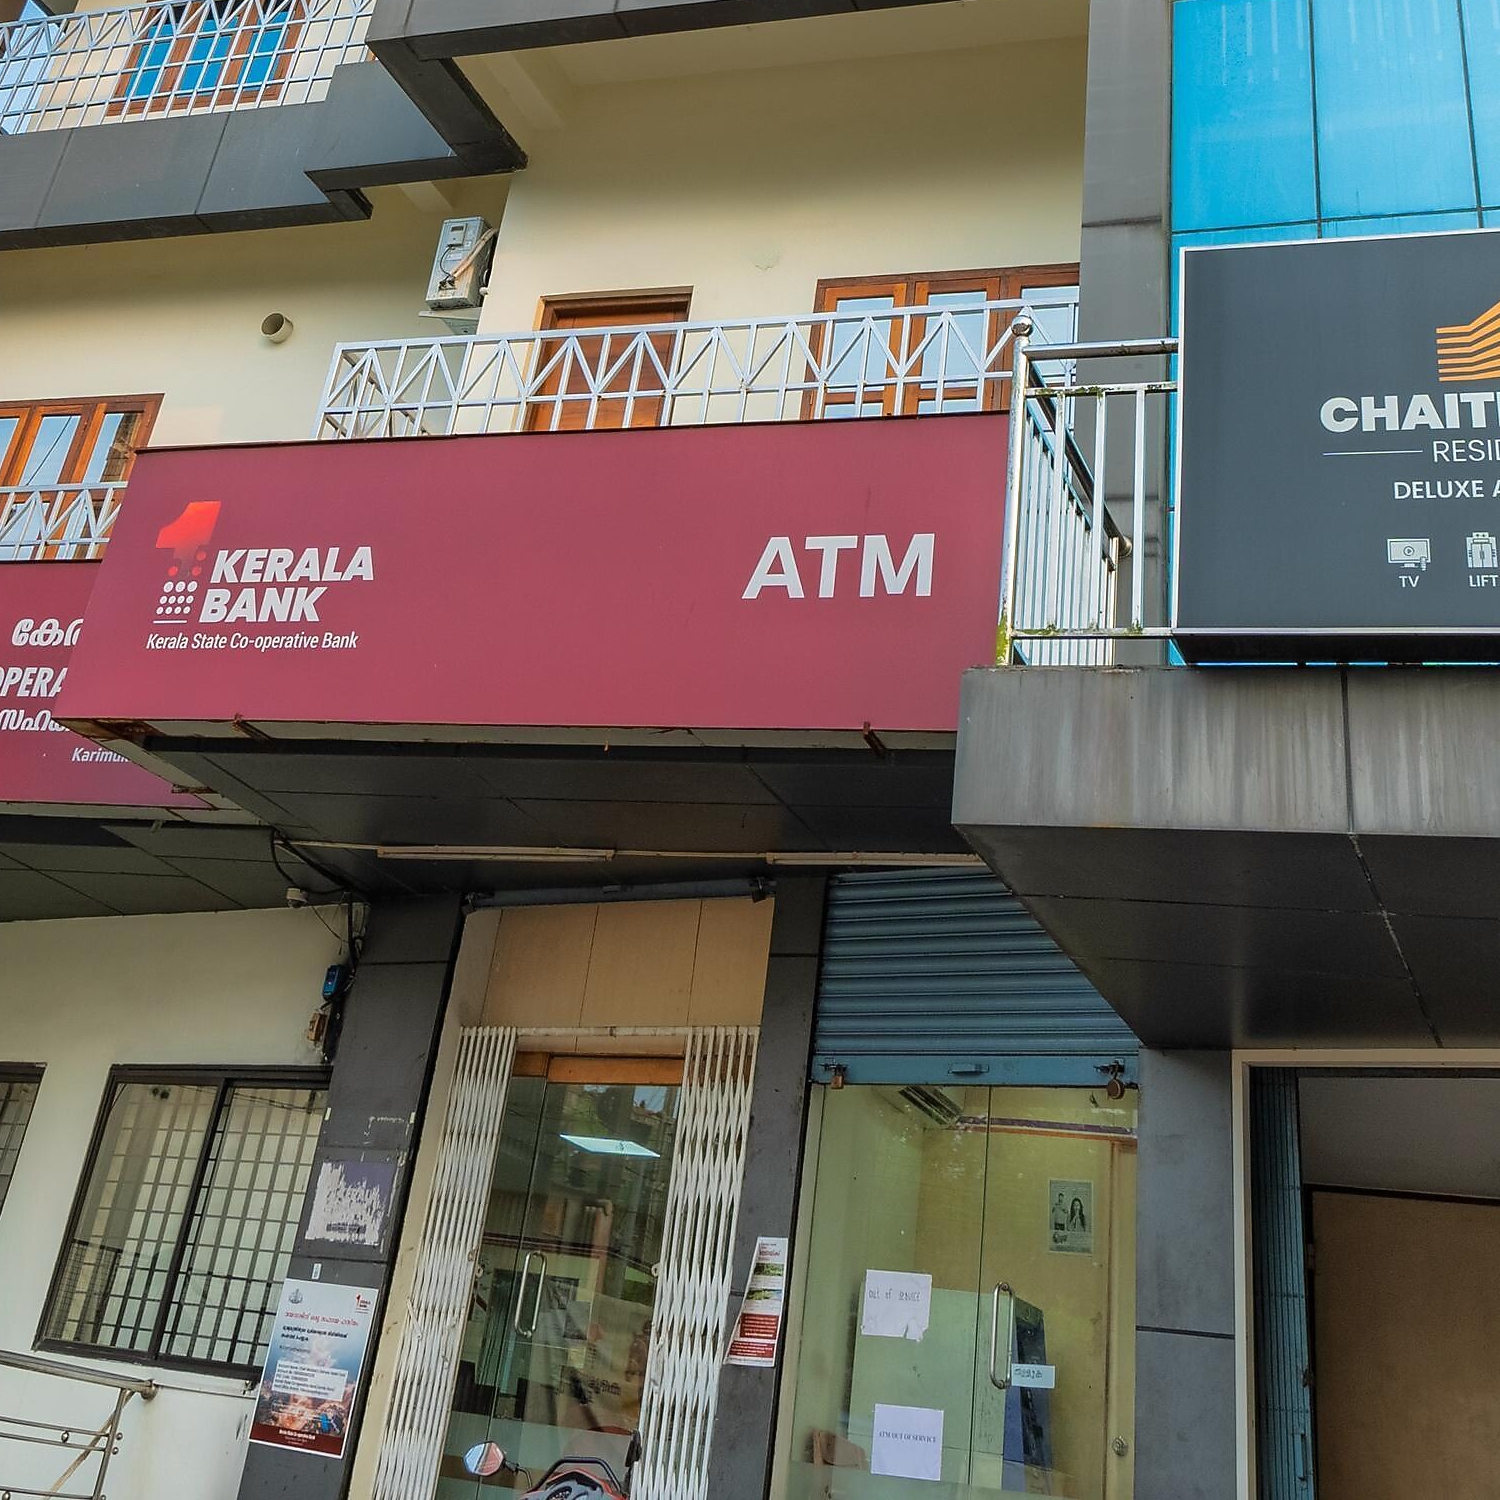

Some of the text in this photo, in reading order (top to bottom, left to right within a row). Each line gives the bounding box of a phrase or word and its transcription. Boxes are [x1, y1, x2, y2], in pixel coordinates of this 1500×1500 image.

[1393, 479, 1485, 500] DELUXE
[210, 546, 375, 583] KERALA
[741, 533, 935, 599] ATM
[1399, 575, 1420, 588] TV
[1469, 575, 1499, 588] LIFT
[199, 586, 328, 623] BANK
[146, 631, 359, 652] Kerala State Co-operative Bank
